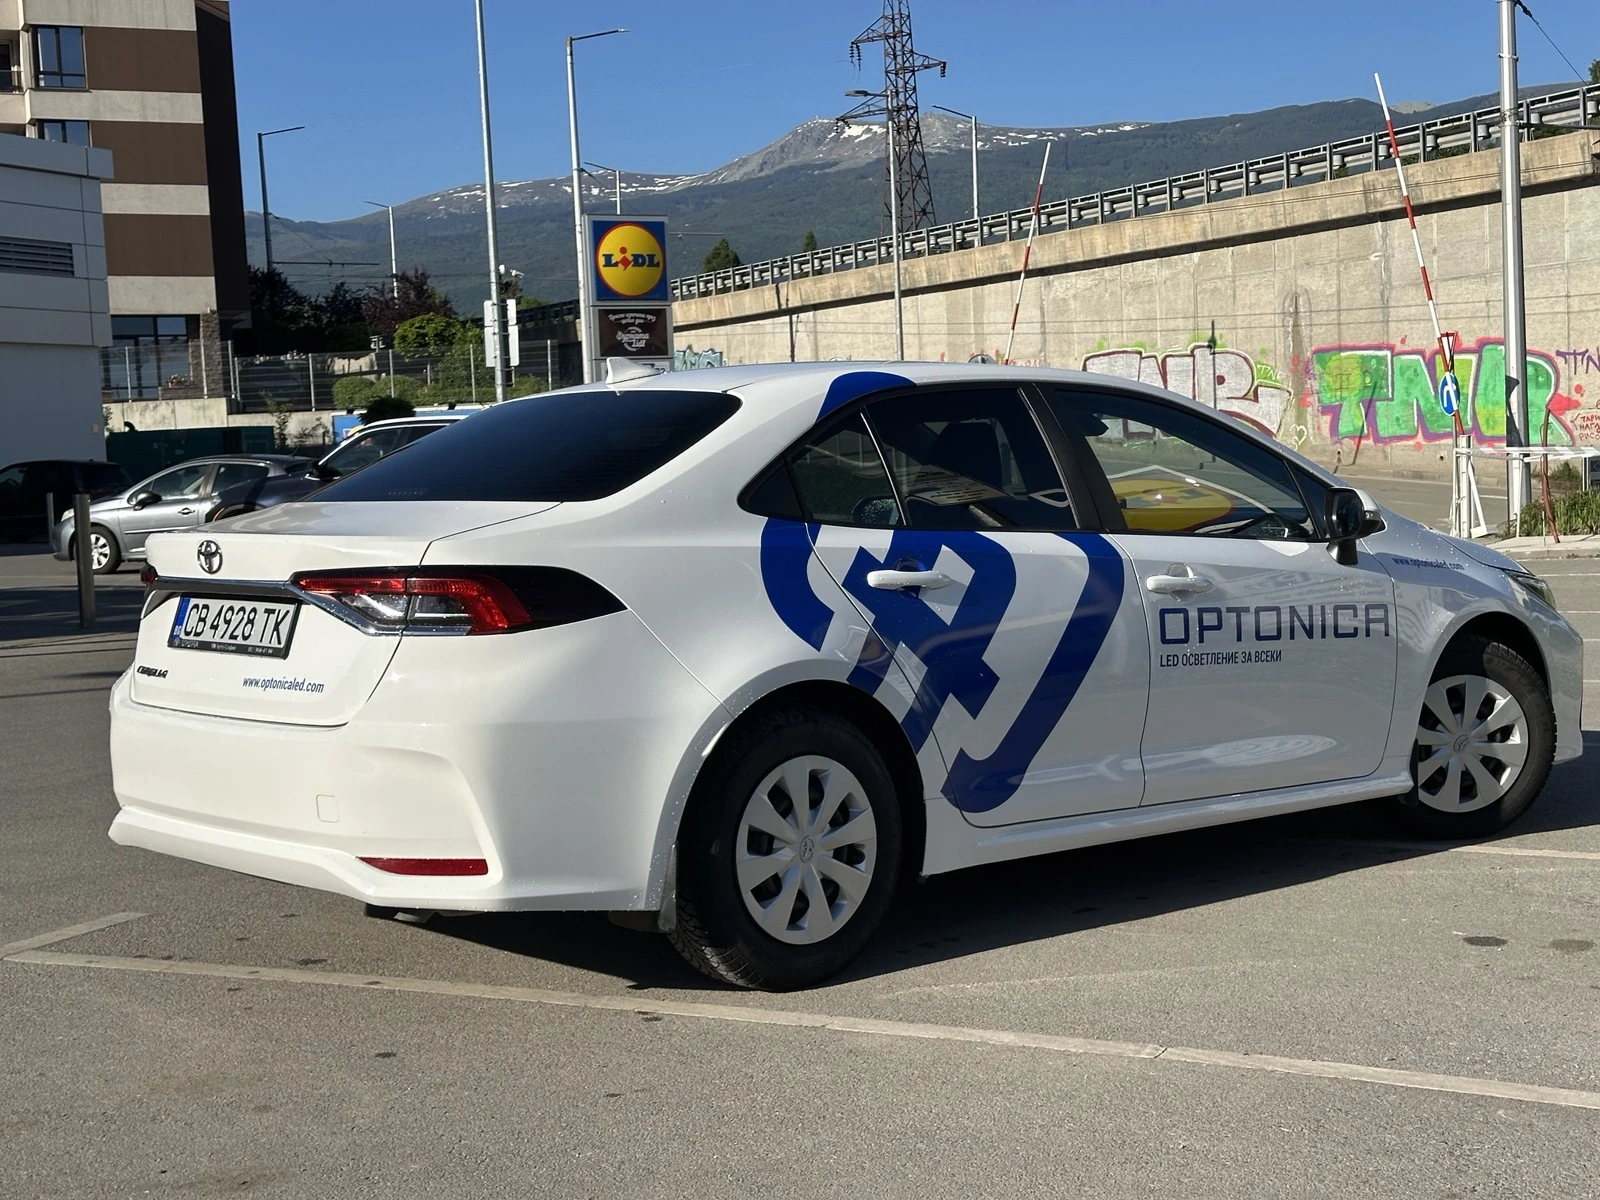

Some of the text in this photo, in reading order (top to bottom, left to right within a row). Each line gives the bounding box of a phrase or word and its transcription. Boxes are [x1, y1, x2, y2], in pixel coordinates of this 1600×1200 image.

[183, 603, 290, 645] CB 4928 TK
[1158, 603, 1390, 645] OPTONICA
[1160, 650, 1282, 667] LED ОСВЕТЛЕНИЕ ЗА ВСЕКИ
[242, 676, 325, 693] www.optonicaled.com
